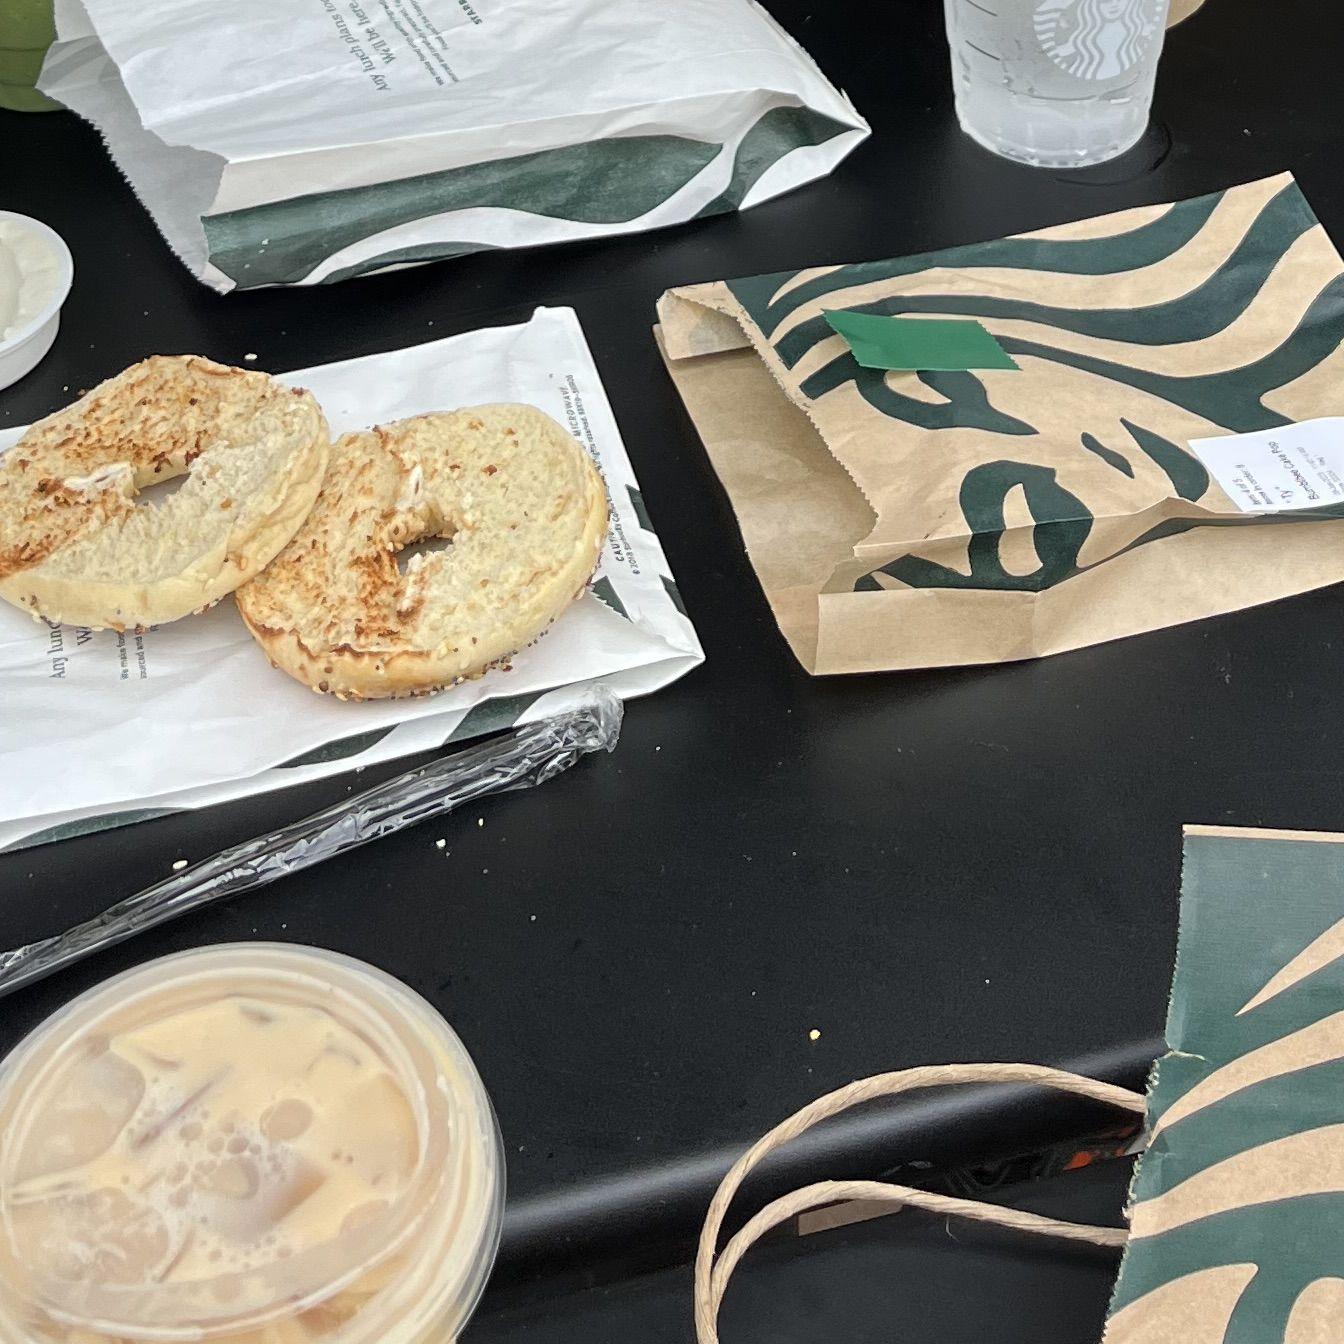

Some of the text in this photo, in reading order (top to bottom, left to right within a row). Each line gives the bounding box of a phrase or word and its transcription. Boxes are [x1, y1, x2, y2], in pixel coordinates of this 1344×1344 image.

[330, 13, 358, 44] plans
[366, 27, 380, 40] be
[371, 39, 396, 63] We'll
[368, 74, 390, 92] Any
[47, 622, 68, 679] Any lunc
